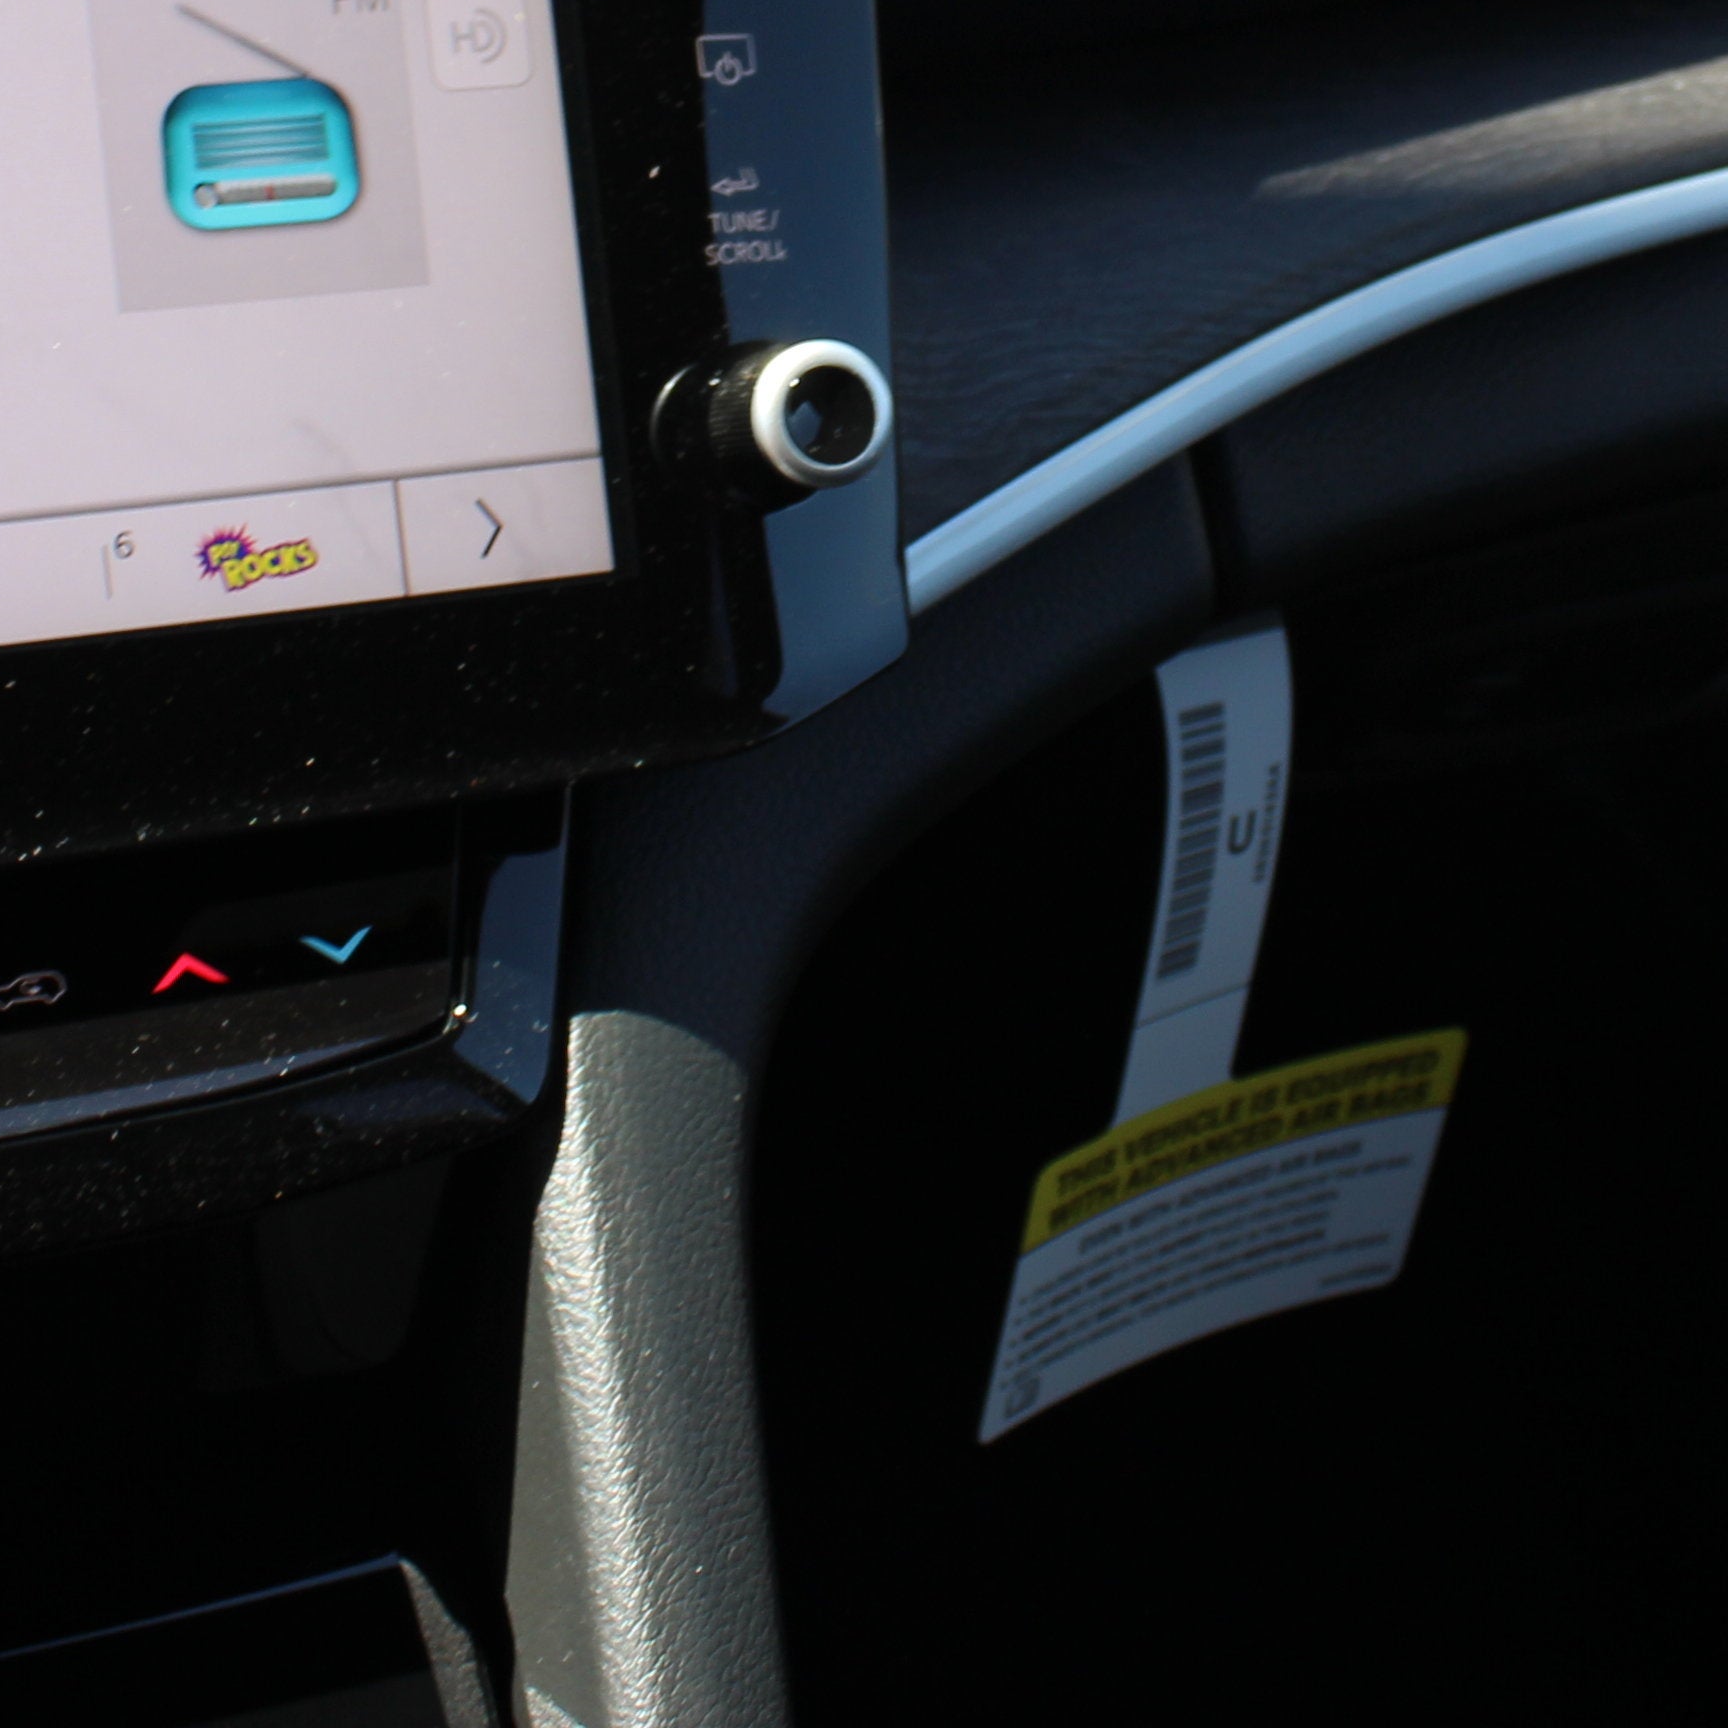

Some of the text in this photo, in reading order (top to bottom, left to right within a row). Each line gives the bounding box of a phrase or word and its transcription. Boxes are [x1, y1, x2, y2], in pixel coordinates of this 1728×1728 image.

[707, 208, 780, 234] TUNE/
[704, 239, 788, 265] SCROLL
[112, 528, 135, 561] 6
[221, 539, 319, 588] ROCKS
